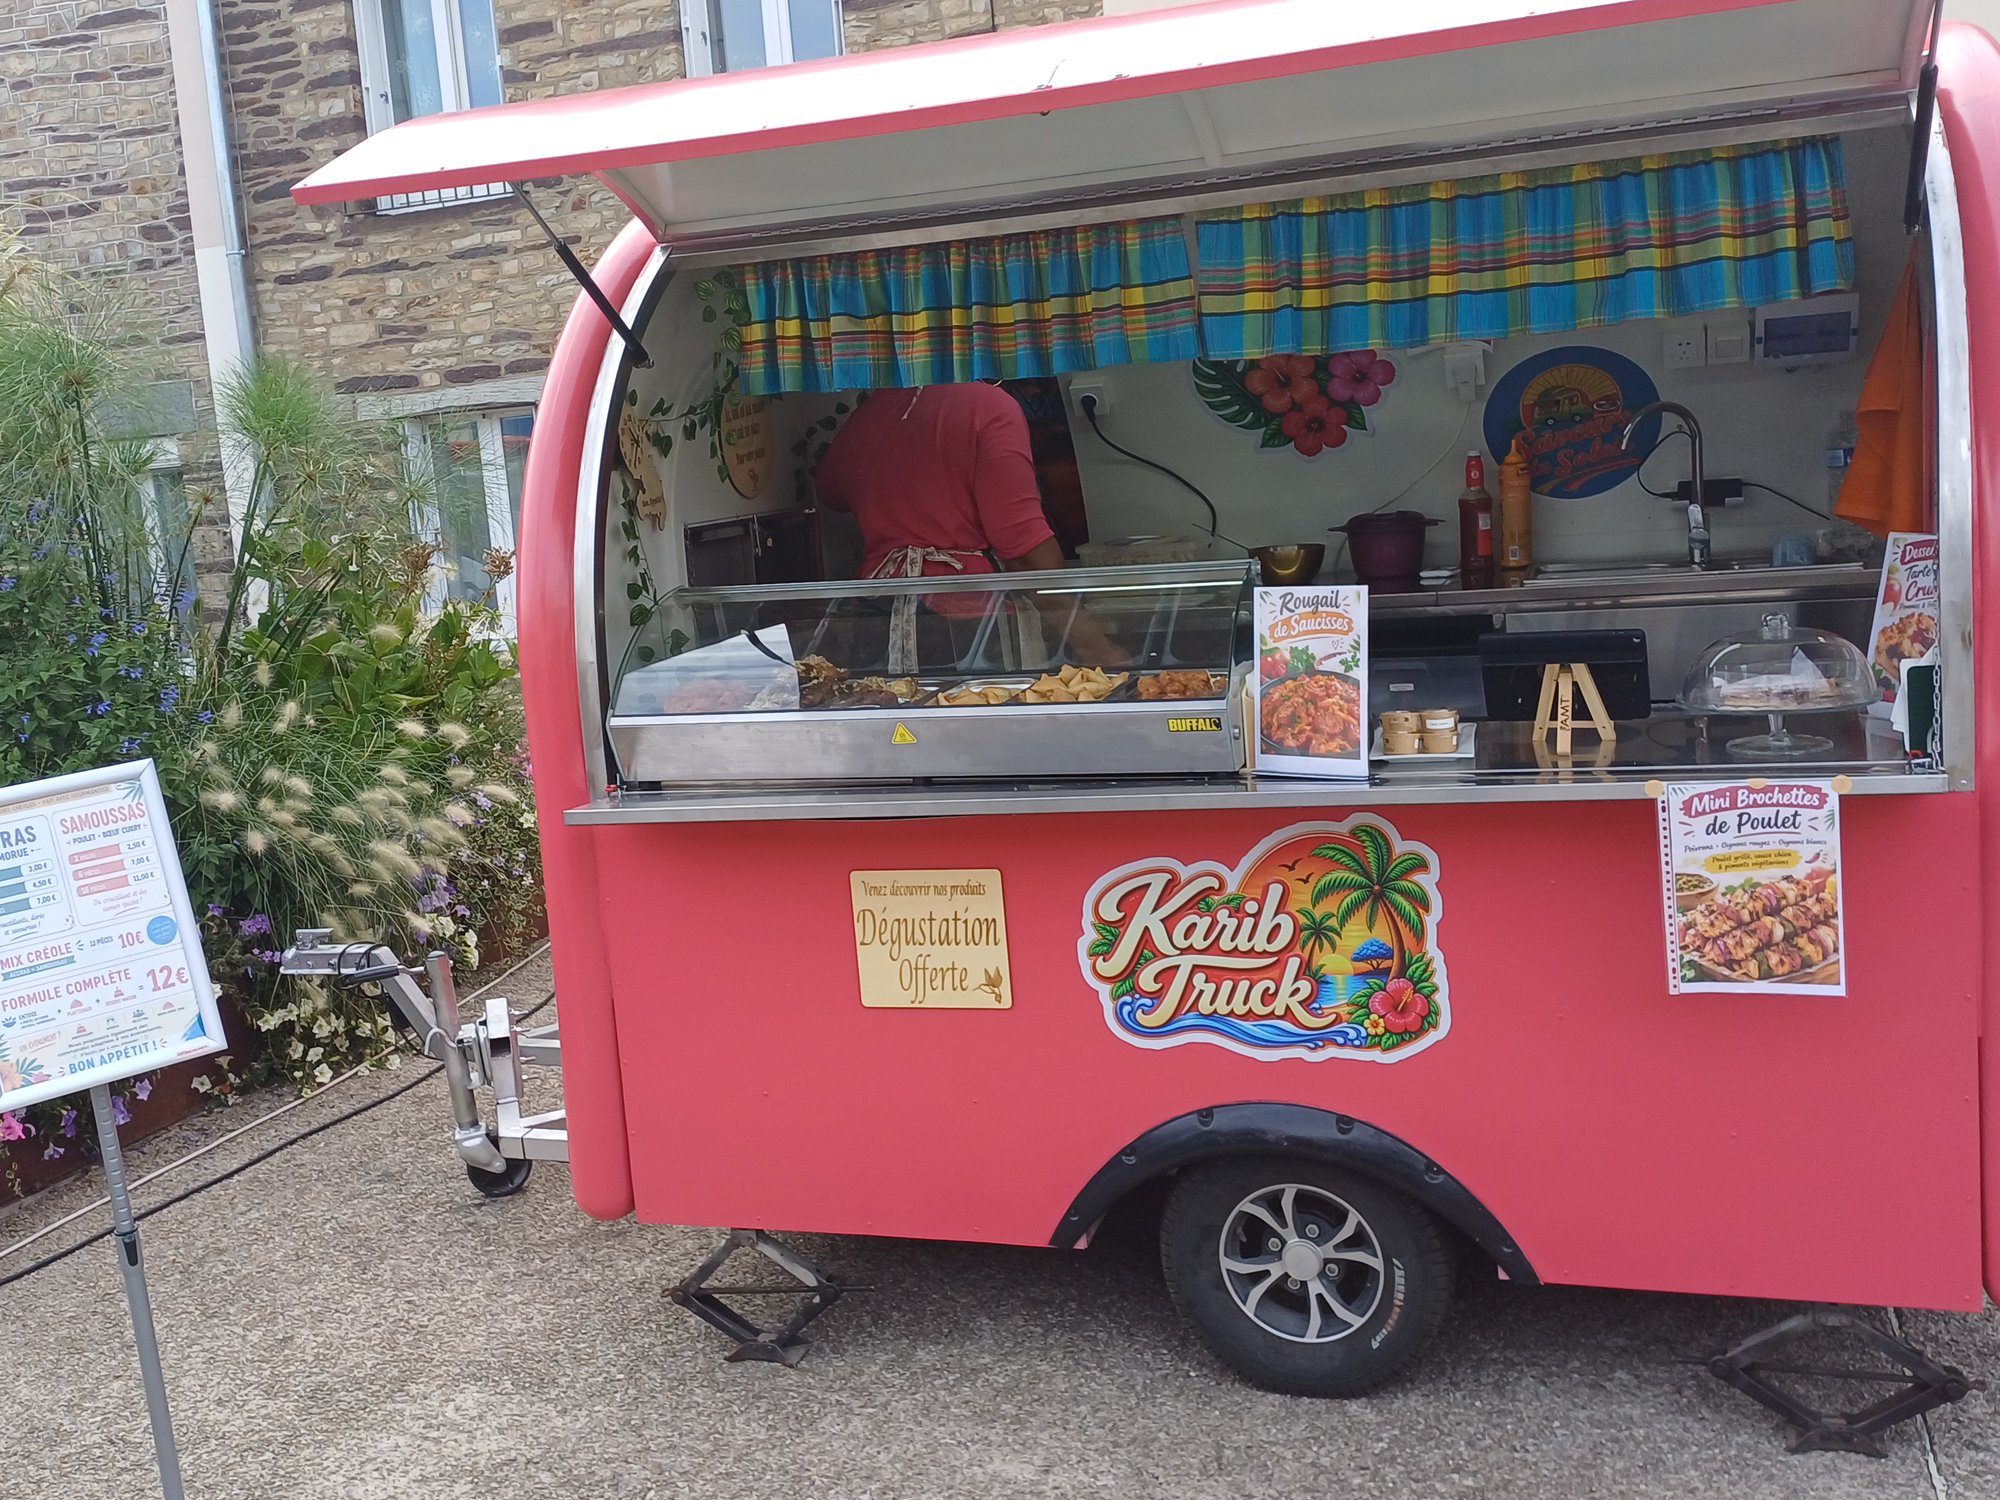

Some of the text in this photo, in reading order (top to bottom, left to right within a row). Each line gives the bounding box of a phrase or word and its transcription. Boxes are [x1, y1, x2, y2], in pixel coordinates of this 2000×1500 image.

[1279, 589, 1342, 616] Rougail
[1274, 612, 1349, 638] de Saucisses
[1691, 787, 1820, 816] Mini Brochettes
[60, 802, 146, 835] SAMOUSSAS
[1705, 809, 1802, 836] de Poulet
[862, 880, 887, 897] Venez
[934, 884, 948, 896] nos
[948, 879, 986, 901] produits
[857, 906, 1000, 962] Dégustation
[1096, 872, 1296, 979] Karib
[0, 955, 24, 971] MIX
[899, 953, 969, 1004] Offerte
[2, 968, 131, 1012] FORMULE COMPLÈTE
[1135, 952, 1337, 1028] Truck
[69, 1057, 95, 1075] BON
[99, 1042, 151, 1067] APPÉTIT
